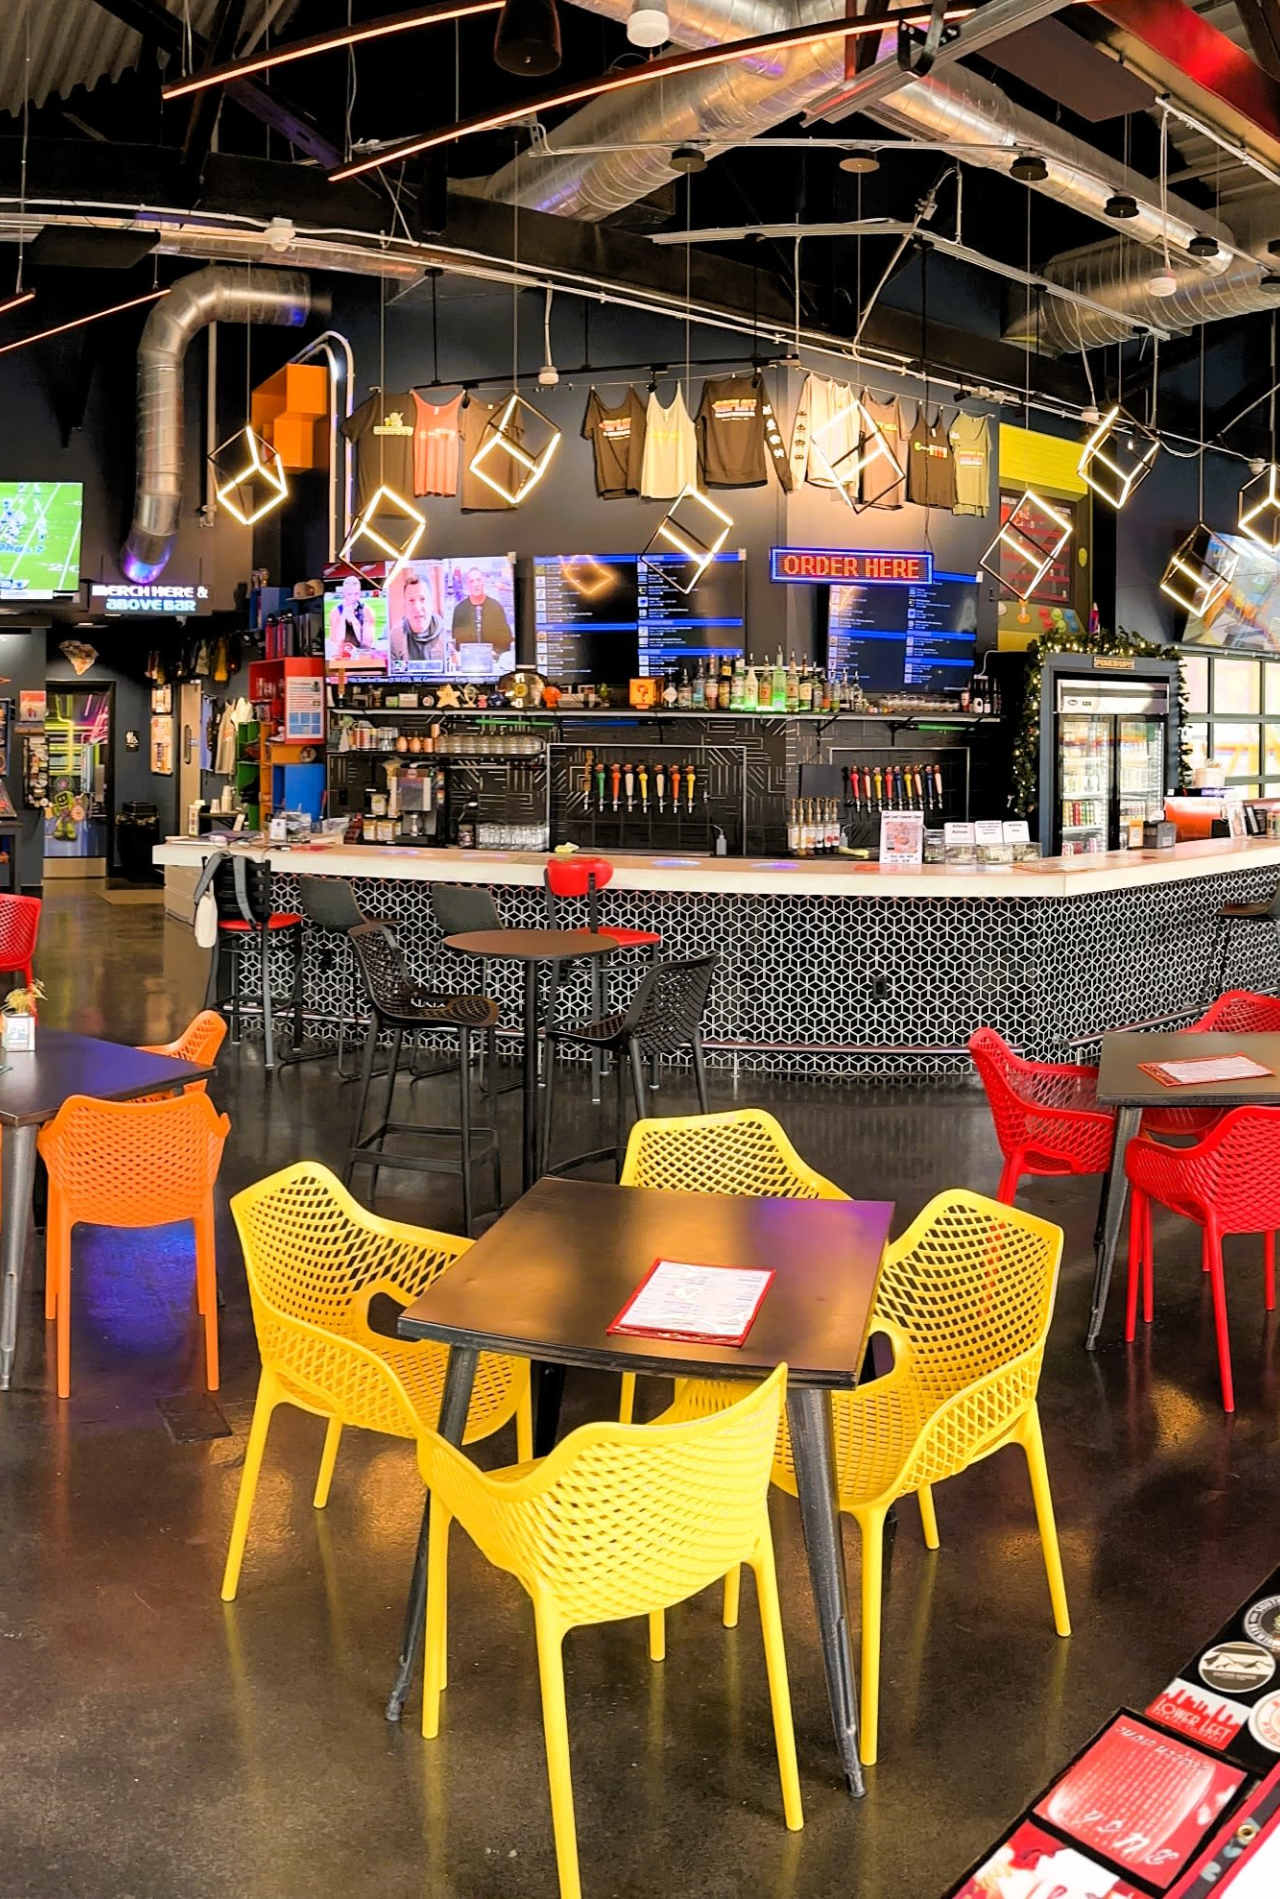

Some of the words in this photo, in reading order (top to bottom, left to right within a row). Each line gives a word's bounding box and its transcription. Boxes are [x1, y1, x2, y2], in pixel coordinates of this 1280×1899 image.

[784, 555, 858, 577] ORDER
[864, 558, 920, 579] HERE
[154, 586, 194, 598] HERE
[197, 586, 209, 598] &
[1156, 1699, 1201, 1728] LOWER
[1201, 1714, 1232, 1741] LEFT
